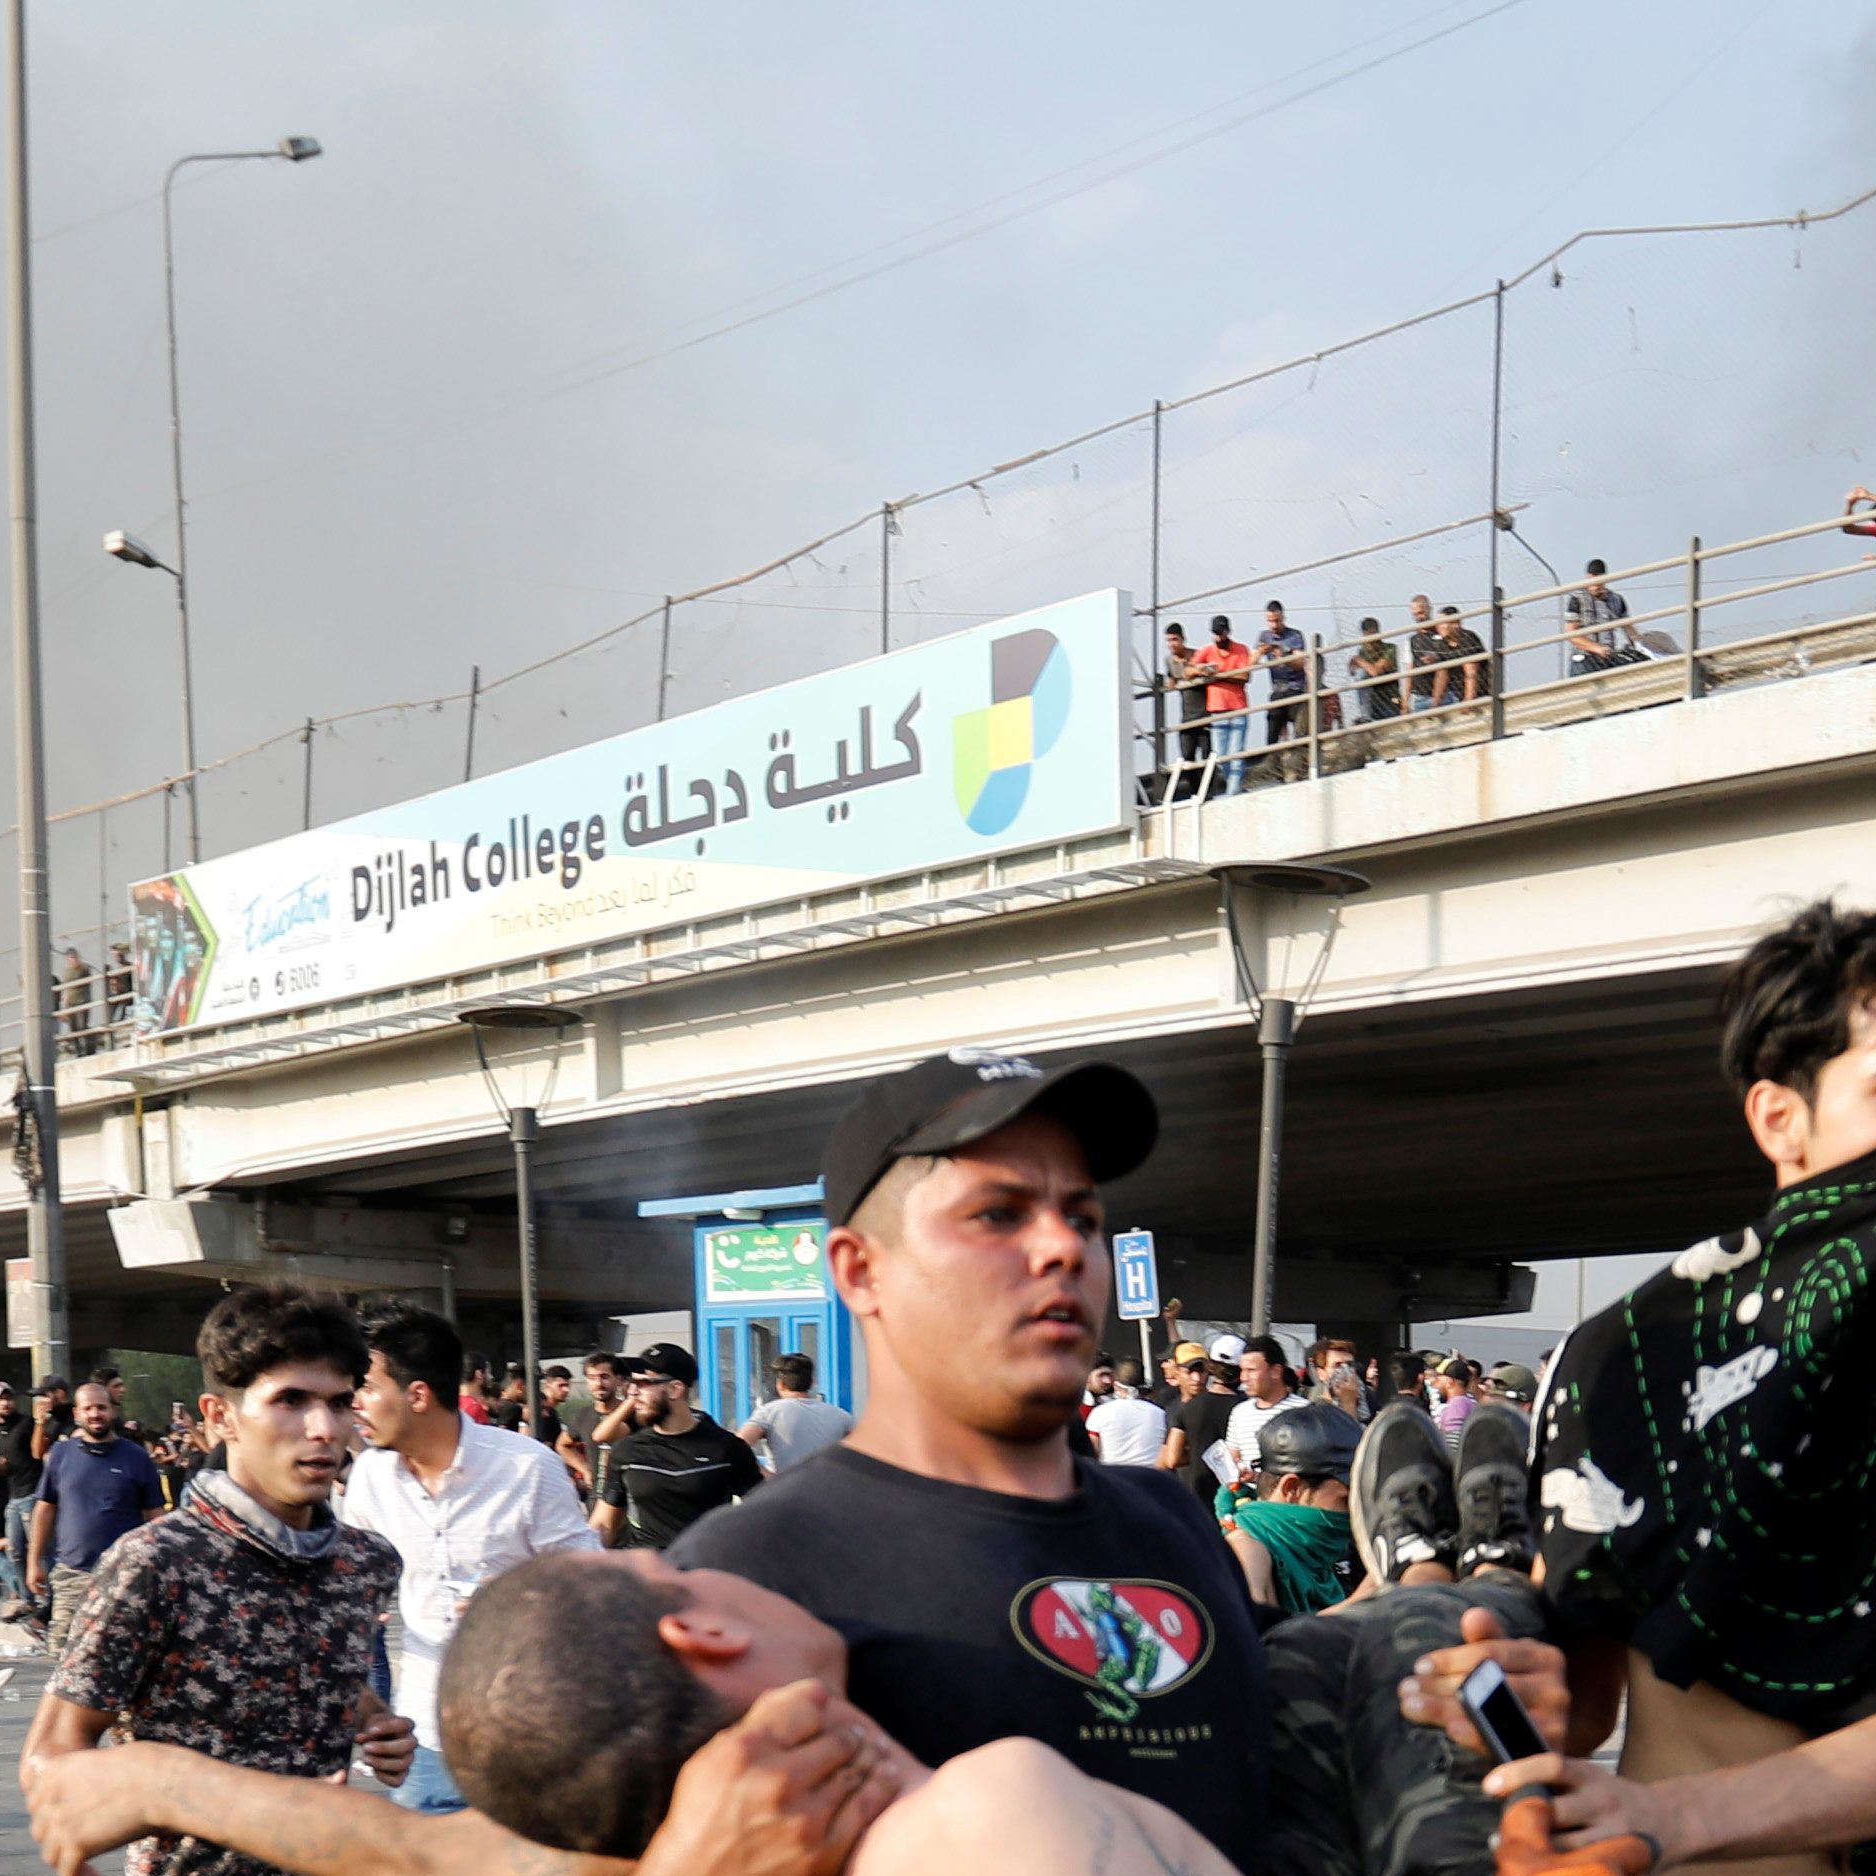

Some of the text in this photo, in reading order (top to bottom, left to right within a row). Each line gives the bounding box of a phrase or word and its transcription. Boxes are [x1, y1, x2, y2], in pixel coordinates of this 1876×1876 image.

[623, 687, 922, 857] كلية دجلة
[351, 813, 606, 933] Dijlah College
[489, 890, 595, 939] Think Beyond
[1126, 1261, 1147, 1299] H
[1054, 1608, 1079, 1639] A
